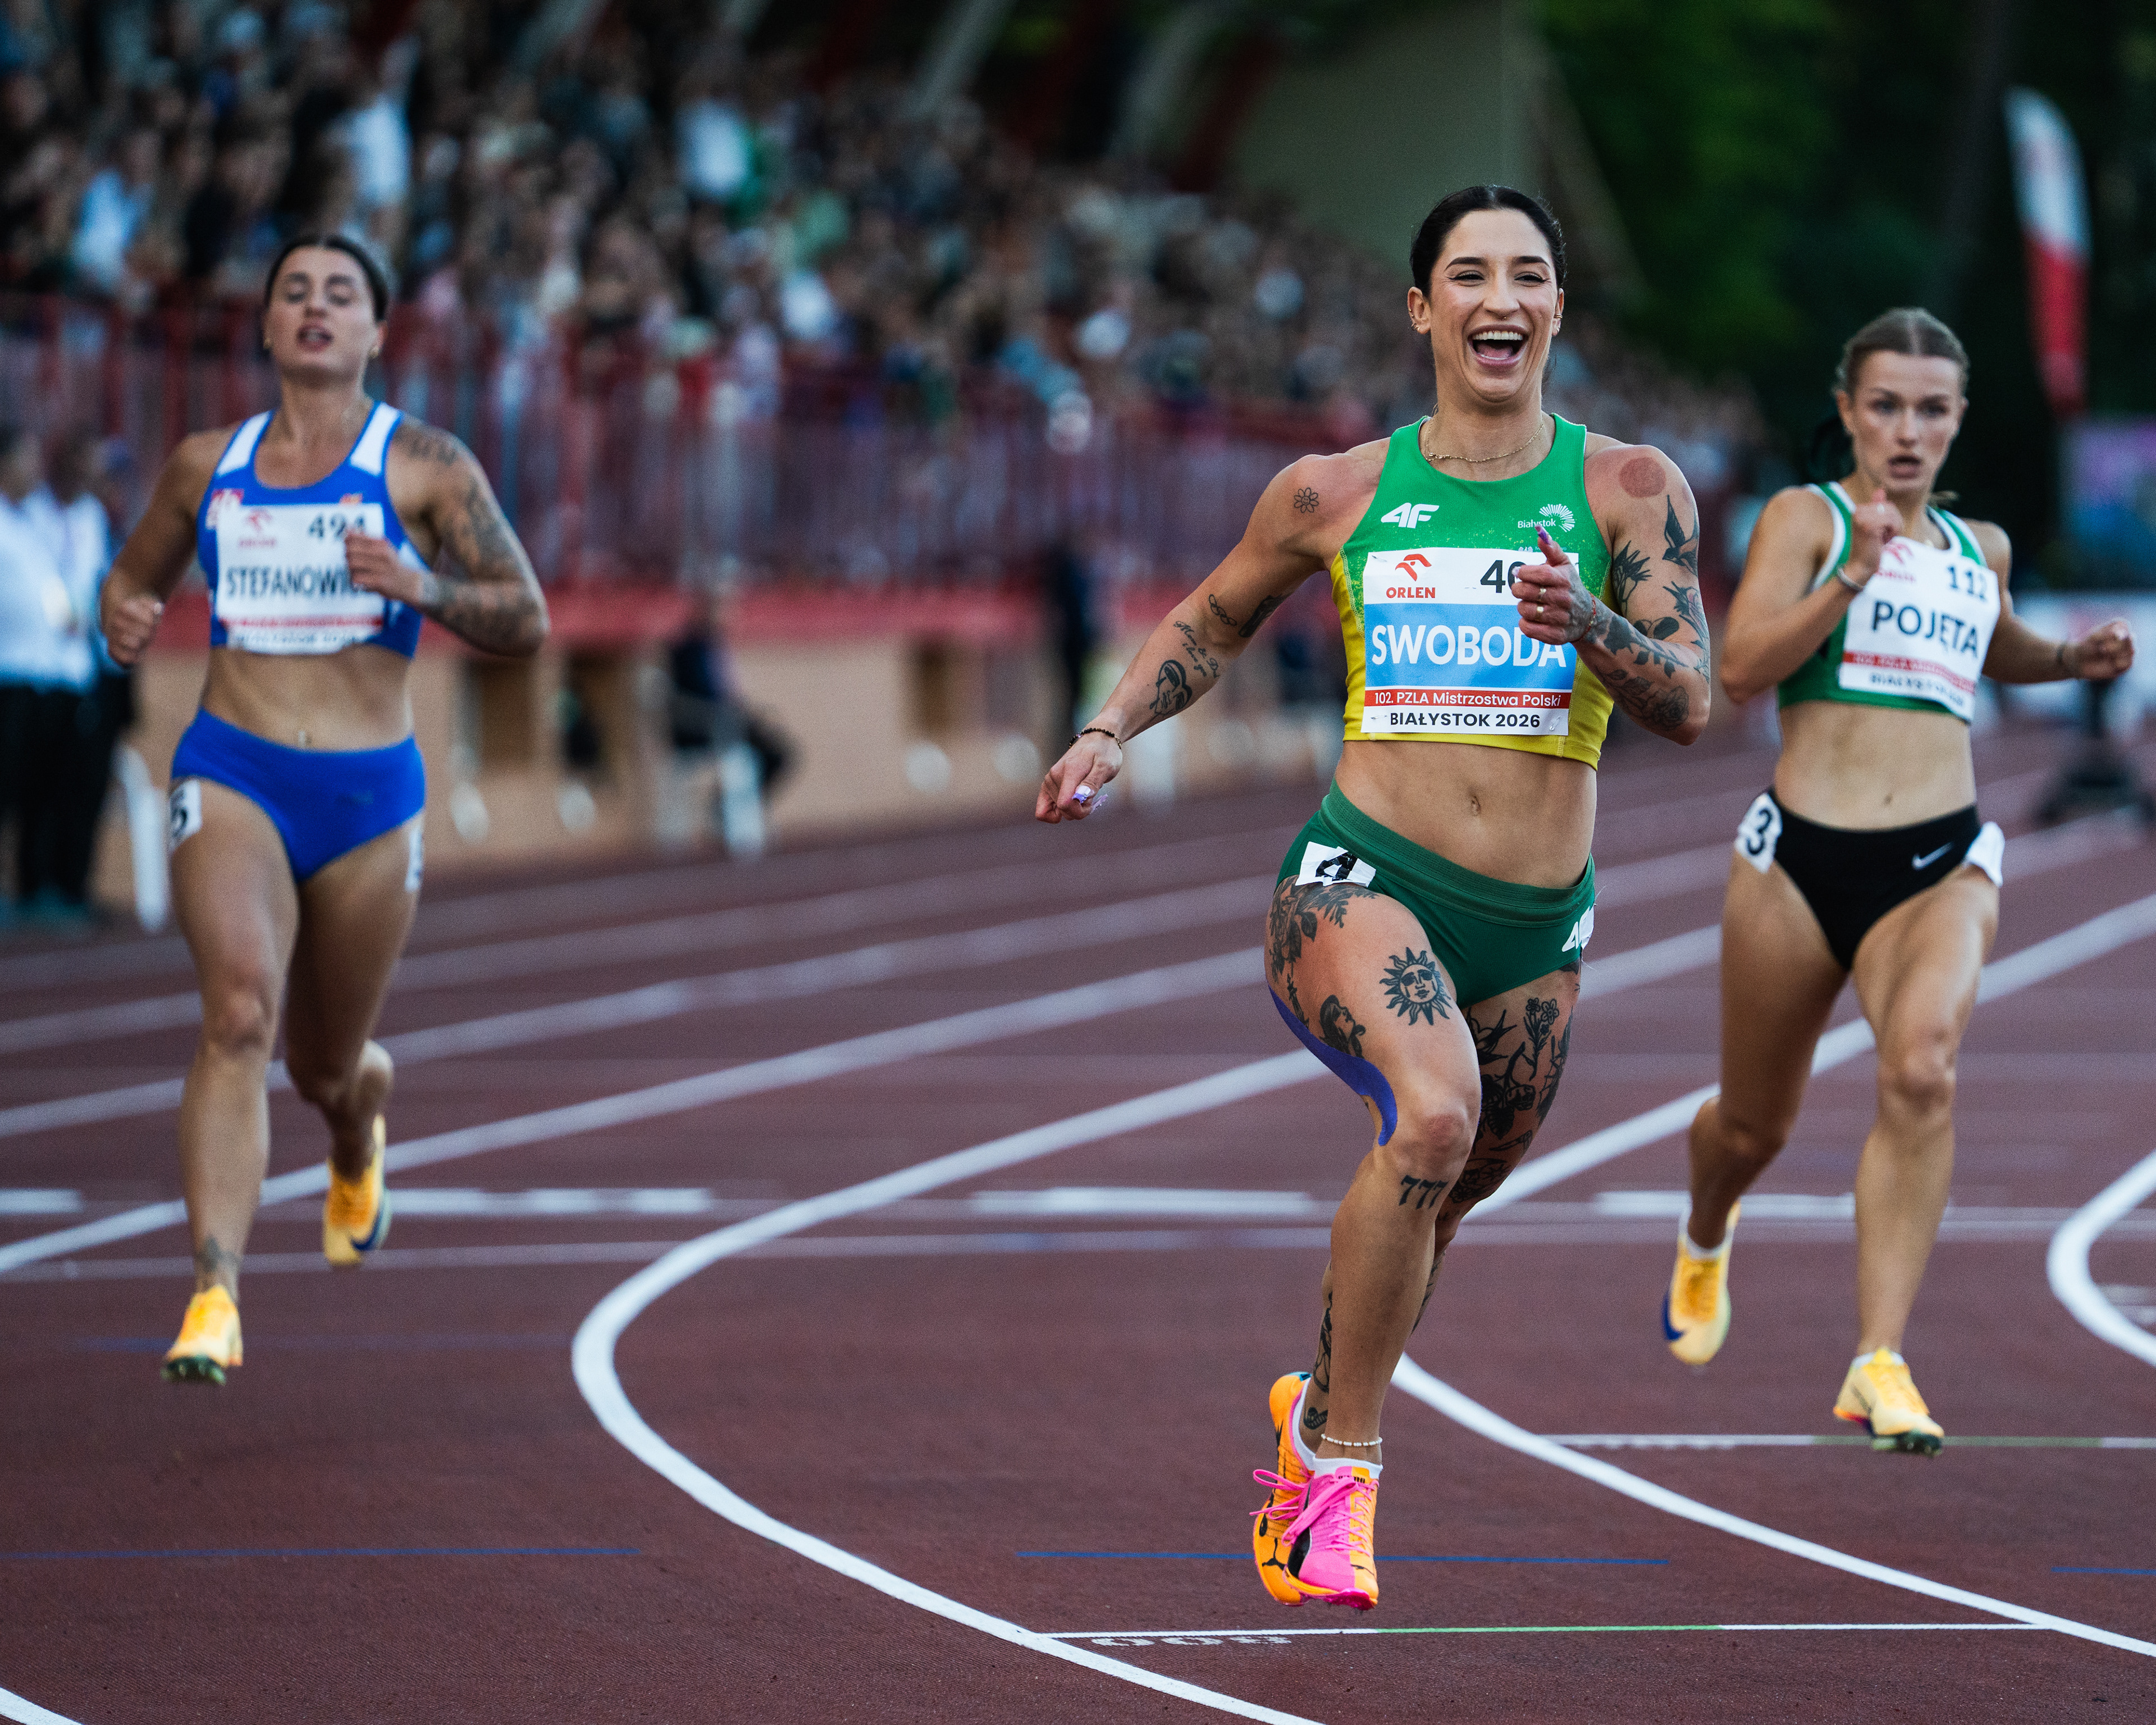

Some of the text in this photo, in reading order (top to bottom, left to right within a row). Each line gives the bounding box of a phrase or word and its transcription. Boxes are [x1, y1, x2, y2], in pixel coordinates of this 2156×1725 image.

[1381, 502, 1440, 528] 4F
[1386, 587, 1436, 599] ORLEN
[1372, 624, 1566, 667] SWOBODA
[1375, 692, 1561, 707] 102. PZLA Mistrzostwa Polski
[1390, 713, 1540, 728] BIAŁYSTOK 2026
[1746, 808, 1773, 855] 3
[1315, 852, 1358, 881] 4
[1399, 1175, 1449, 1210] 777
